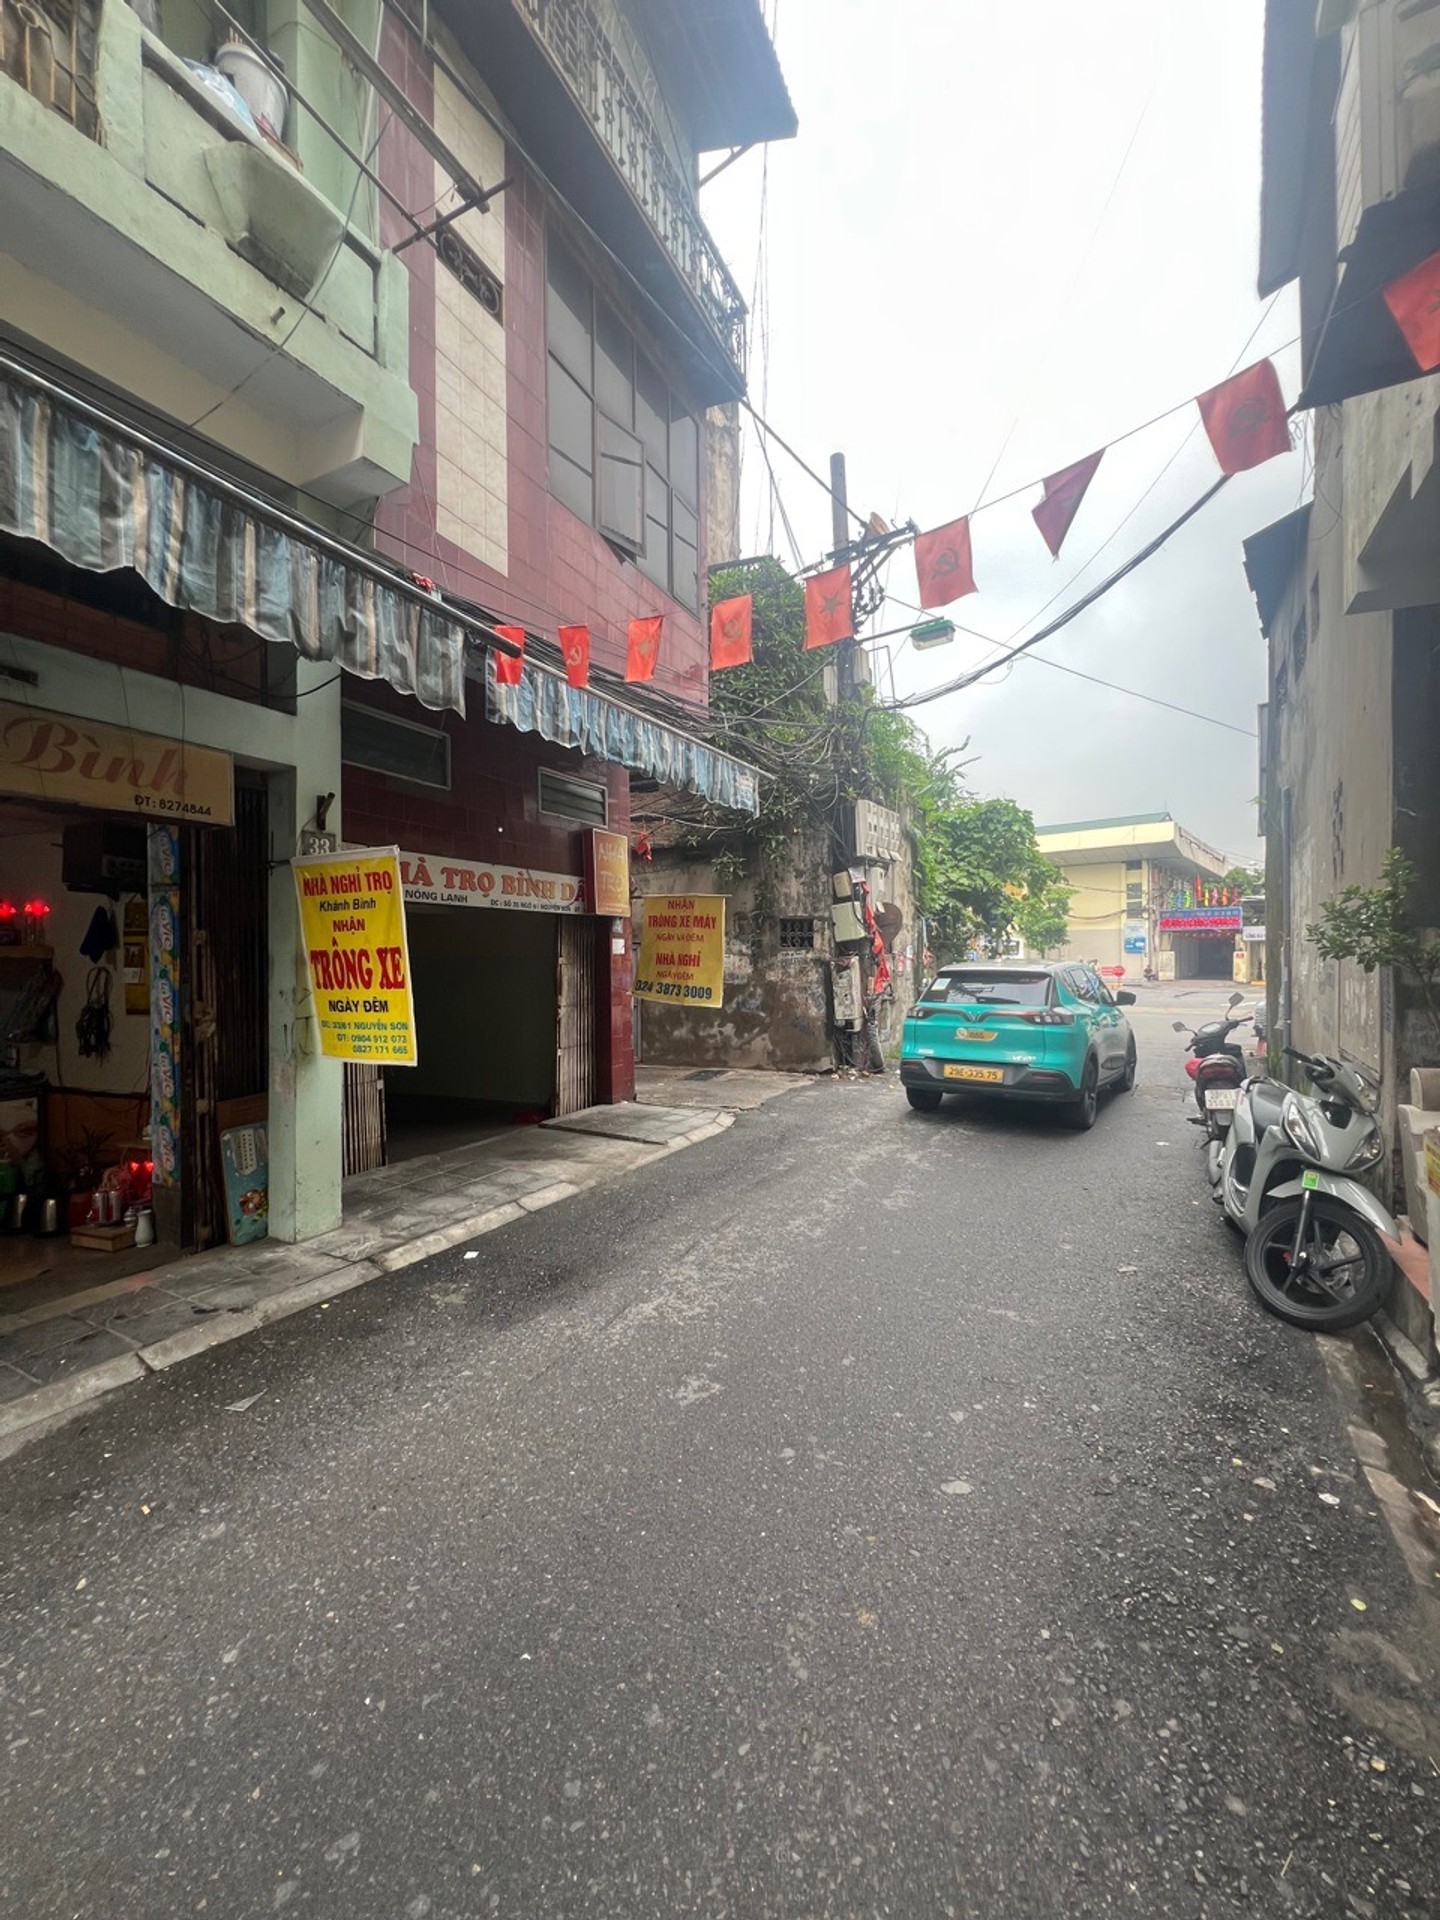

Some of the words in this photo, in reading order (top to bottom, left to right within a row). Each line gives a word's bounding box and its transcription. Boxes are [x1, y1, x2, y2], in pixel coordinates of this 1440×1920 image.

[3, 717, 189, 795] Bình
[309, 838, 330, 855] 33
[303, 872, 328, 897] NHÀ
[330, 865, 362, 895] NGHỈ
[364, 870, 393, 895] TRỌ
[441, 867, 495, 897] TRỌ
[501, 870, 555, 899] BÌNH
[319, 899, 350, 912] Khánh
[352, 897, 377, 910] Bình
[404, 889, 438, 901] NÓNG
[440, 893, 468, 905] LẠNH
[333, 915, 365, 935] NHẬN
[679, 915, 691, 928] XE
[692, 914, 717, 929] MÁY
[309, 936, 374, 991] TRÔNG
[375, 946, 405, 990] XE
[655, 951, 675, 966] NHÀ
[676, 950, 702, 967] NGHỈ
[634, 979, 653, 991] 024
[656, 982, 682, 996] 3873
[683, 986, 712, 999] 3009
[328, 996, 360, 1013] NGÀY
[362, 996, 389, 1013] ĐÊM
